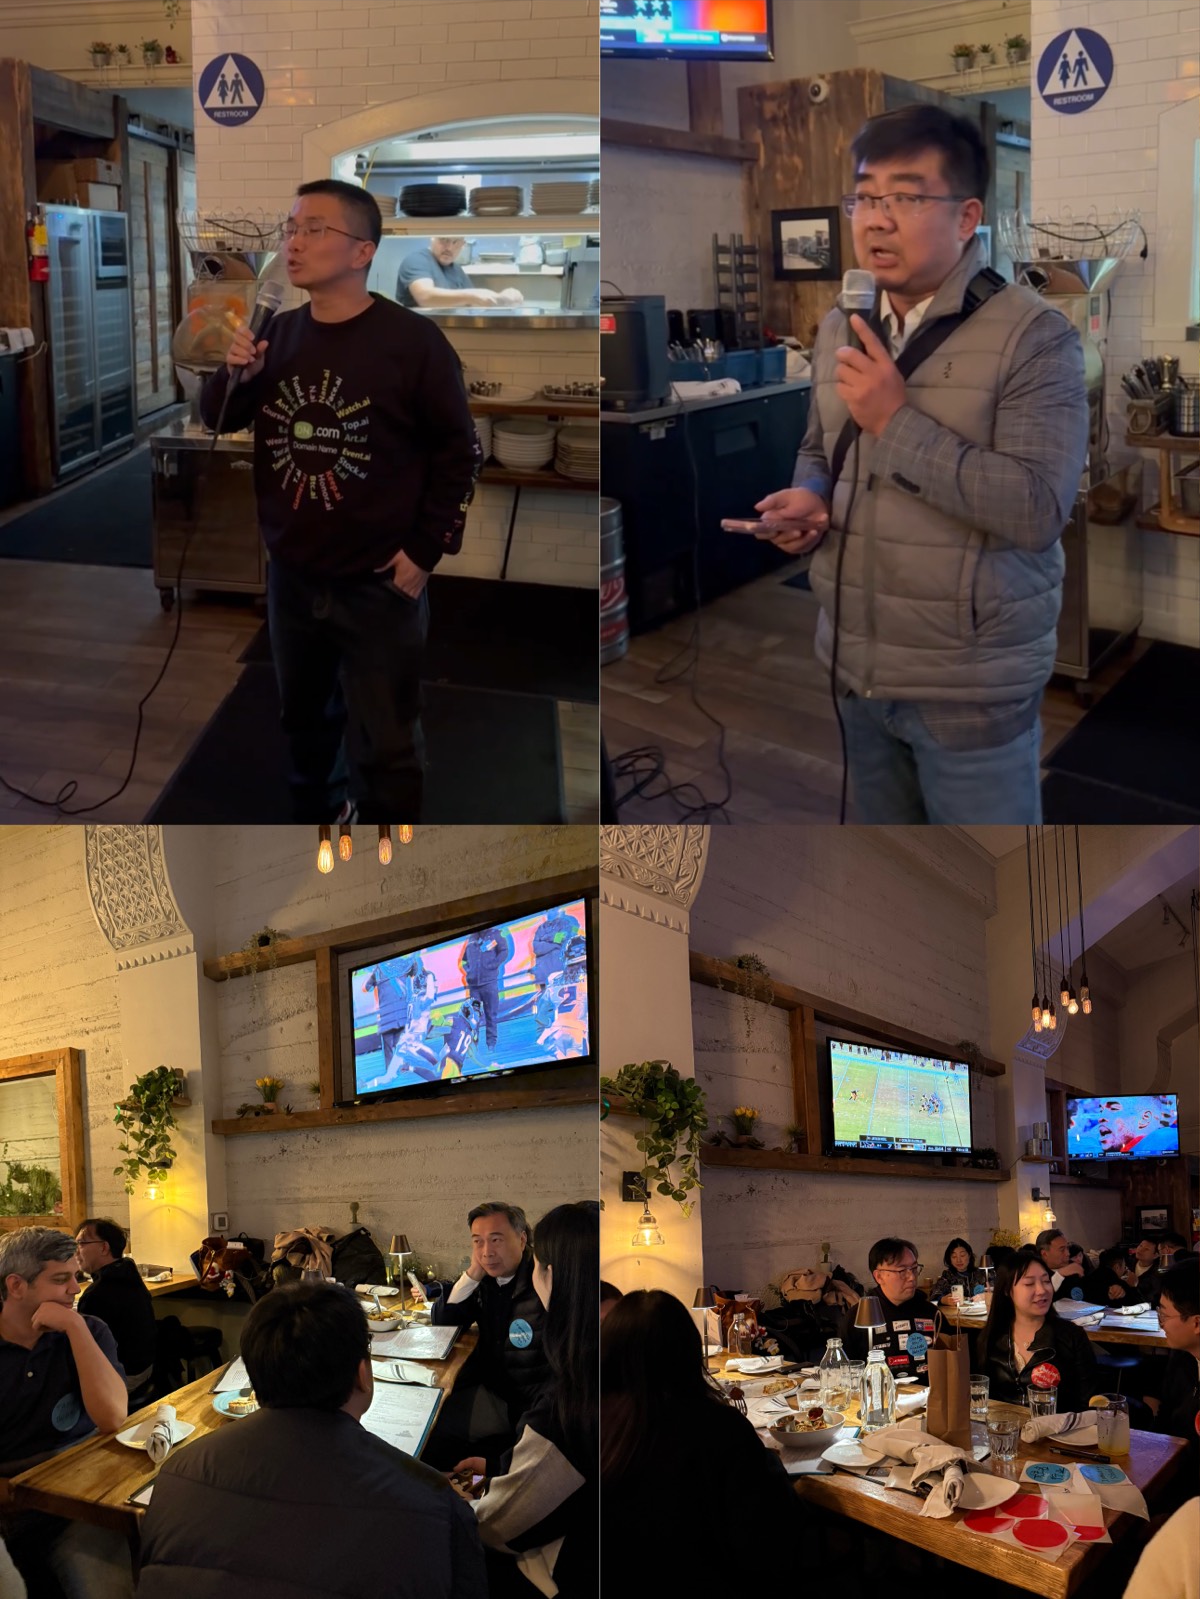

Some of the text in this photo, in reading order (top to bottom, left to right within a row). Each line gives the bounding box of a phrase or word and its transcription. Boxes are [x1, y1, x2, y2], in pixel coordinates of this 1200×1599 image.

[1053, 93, 1095, 106] RESTROOM
[214, 110, 249, 118] RESTROOM
[336, 396, 372, 419] Watch.ai
[341, 416, 370, 431] Top.ai
[343, 433, 368, 443] Art.ai
[293, 441, 339, 455] Domain Name
